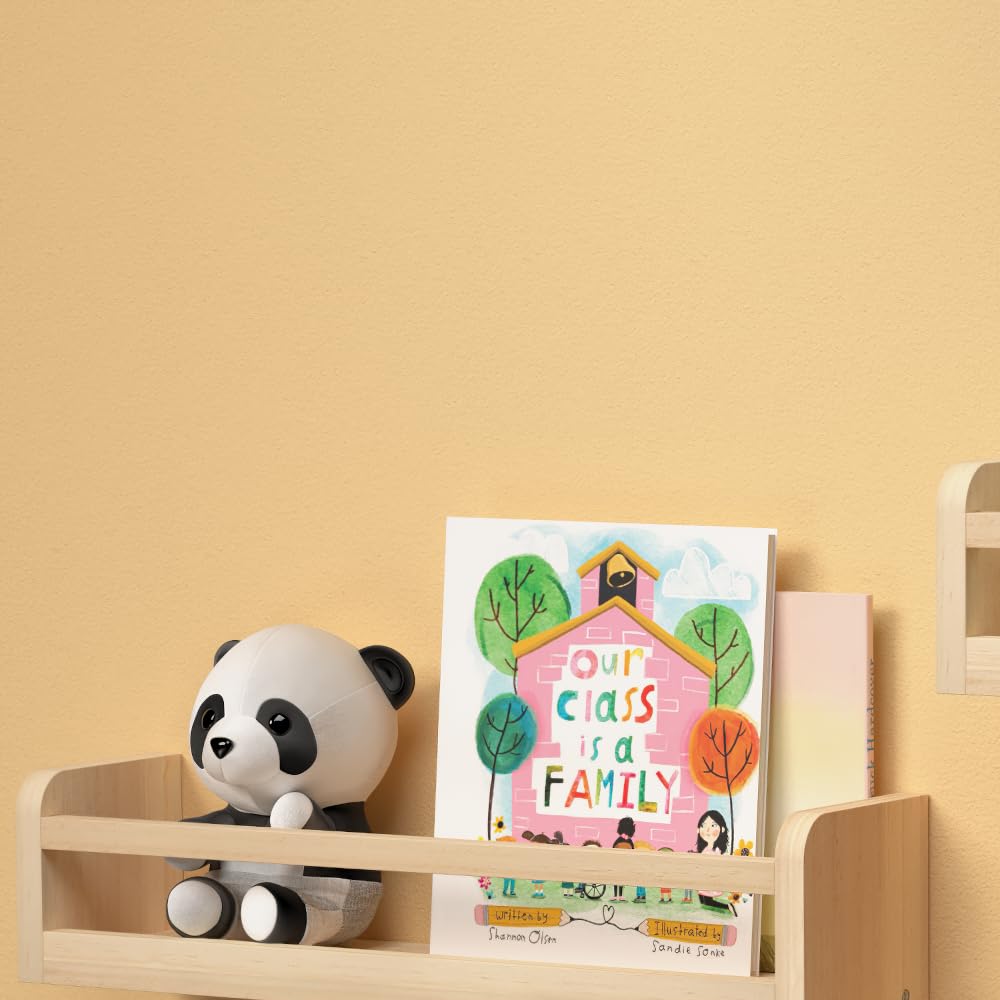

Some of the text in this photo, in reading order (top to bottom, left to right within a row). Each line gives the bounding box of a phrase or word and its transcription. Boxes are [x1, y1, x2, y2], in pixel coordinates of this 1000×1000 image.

[580, 735, 634, 763] is a
[544, 765, 680, 815] FAMILY
[537, 911, 548, 924] by
[489, 926, 557, 944] Shannon Olsen
[654, 921, 721, 941] Illustrated by
[652, 940, 691, 954] Sandie
